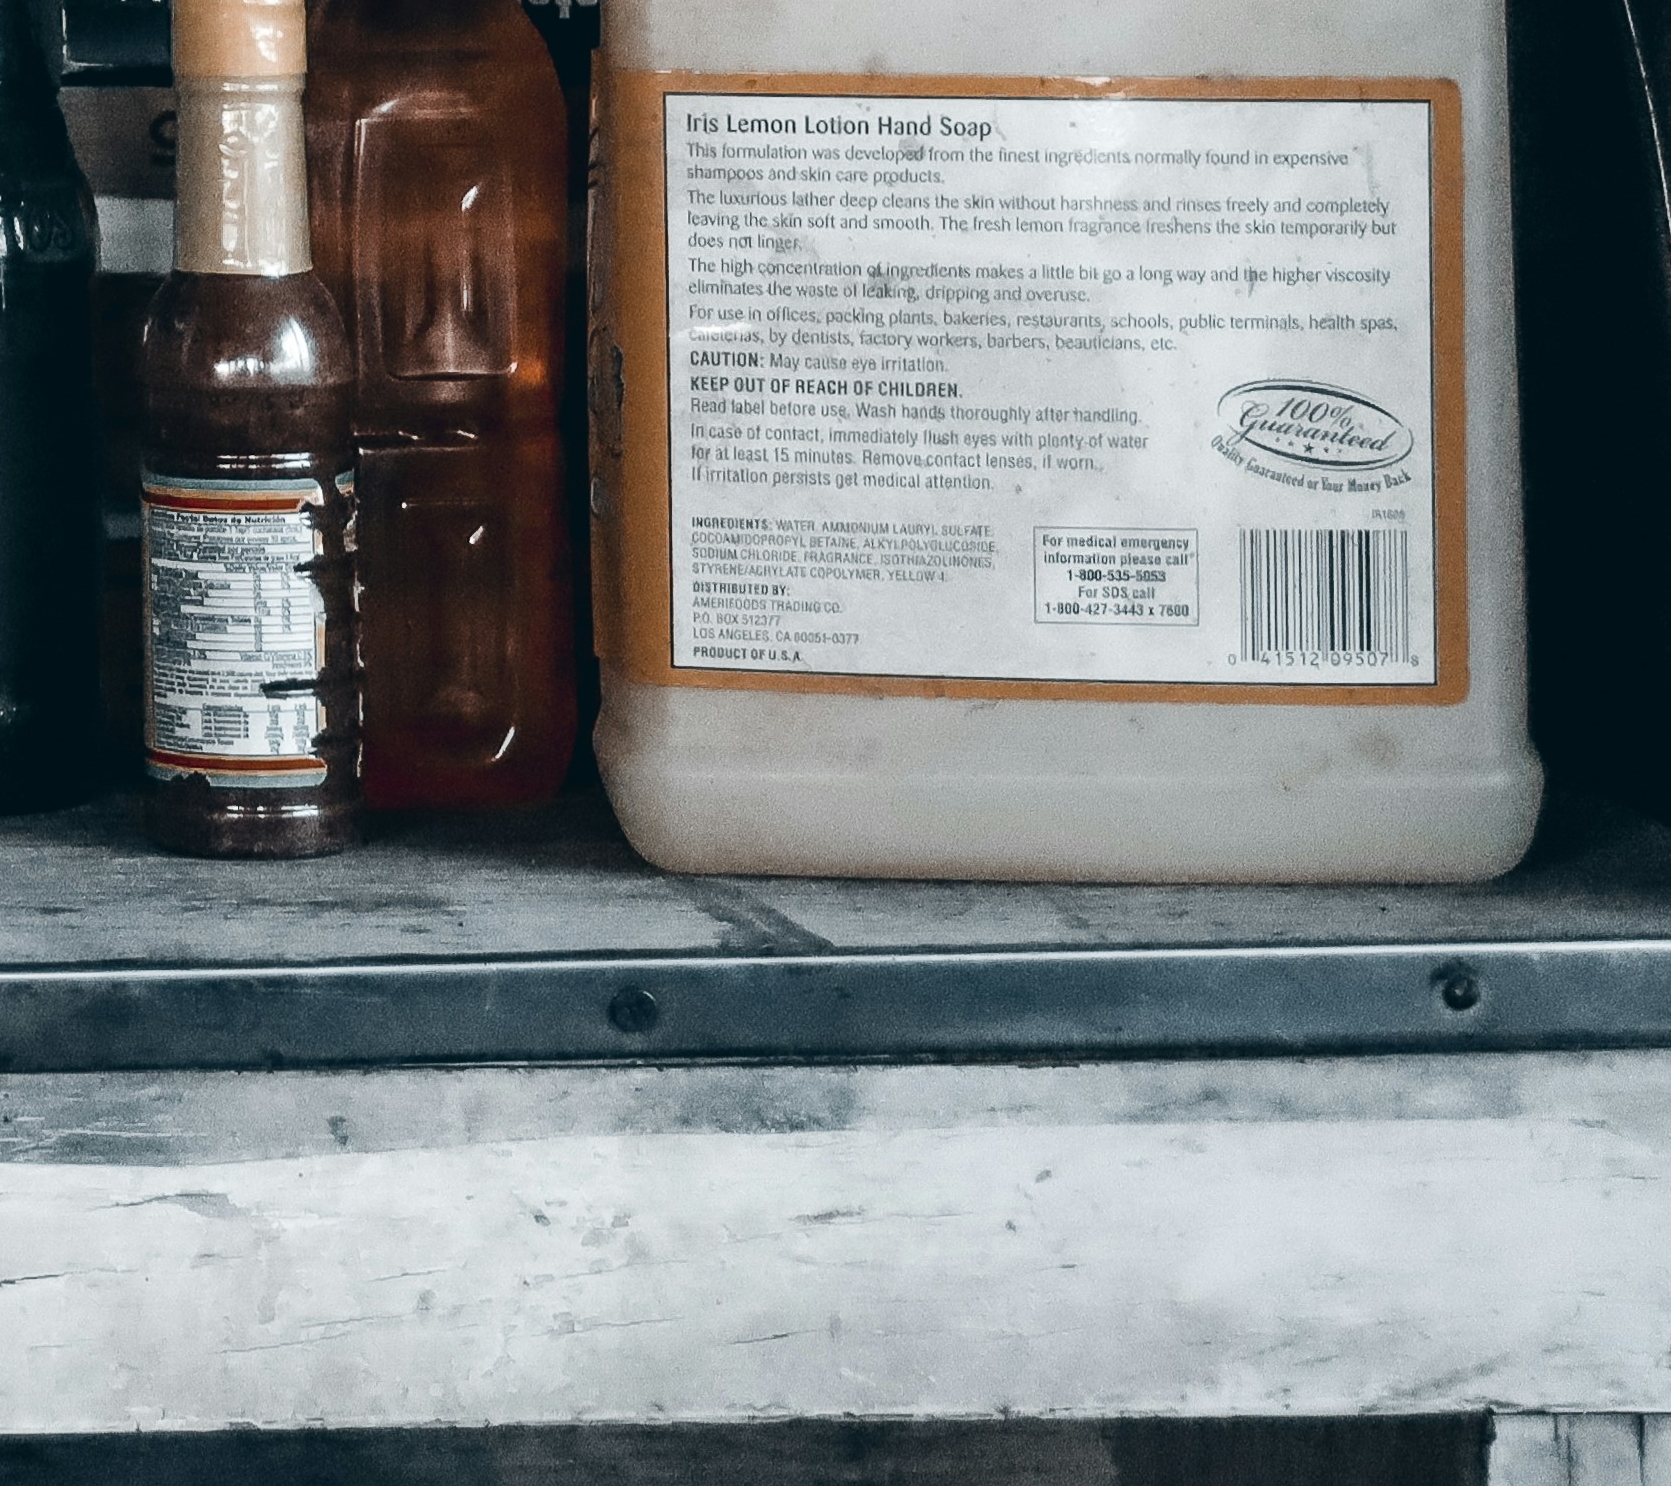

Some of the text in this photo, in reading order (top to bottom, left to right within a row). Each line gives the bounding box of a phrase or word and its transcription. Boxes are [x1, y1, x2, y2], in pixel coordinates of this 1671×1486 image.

[685, 112, 994, 141] Iris Lemon Lotion Hand Soap
[688, 349, 947, 374] CAUTION: May cause eye irritation.
[689, 374, 959, 399] KEEP OUT OF REACH OF CHILDREN.
[1231, 400, 1391, 453] Guaranteed
[1276, 395, 1352, 431] 100%
